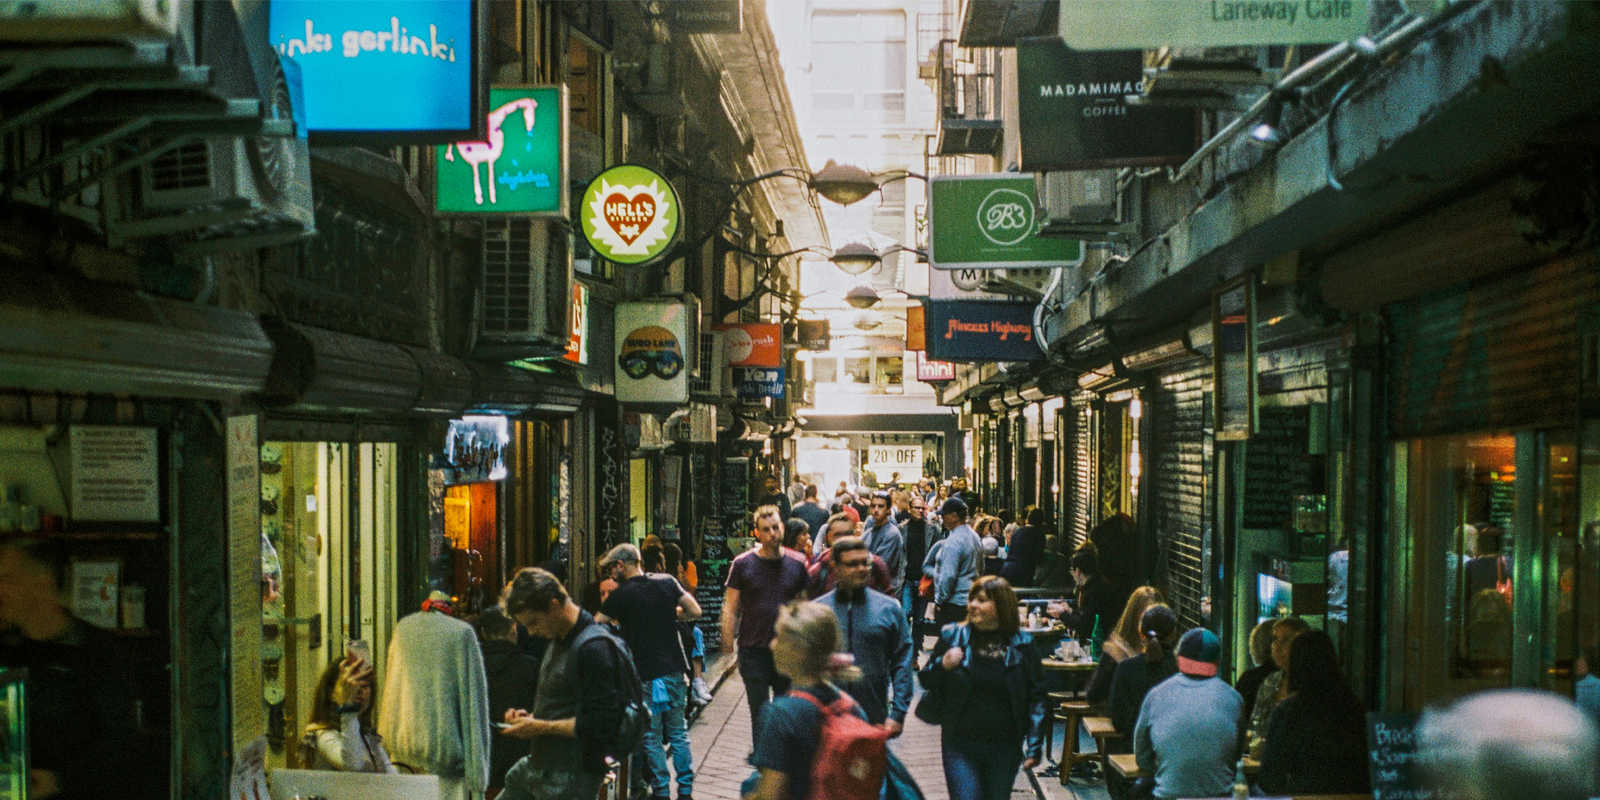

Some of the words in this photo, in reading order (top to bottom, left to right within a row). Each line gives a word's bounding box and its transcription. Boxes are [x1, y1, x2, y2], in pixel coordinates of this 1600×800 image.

[1212, 0, 1297, 25] Laneway
[606, 201, 653, 217] HELL'S
[945, 319, 988, 339] Princess
[991, 321, 1031, 341] Highway
[920, 362, 951, 376] mini
[896, 449, 917, 464] OFF
